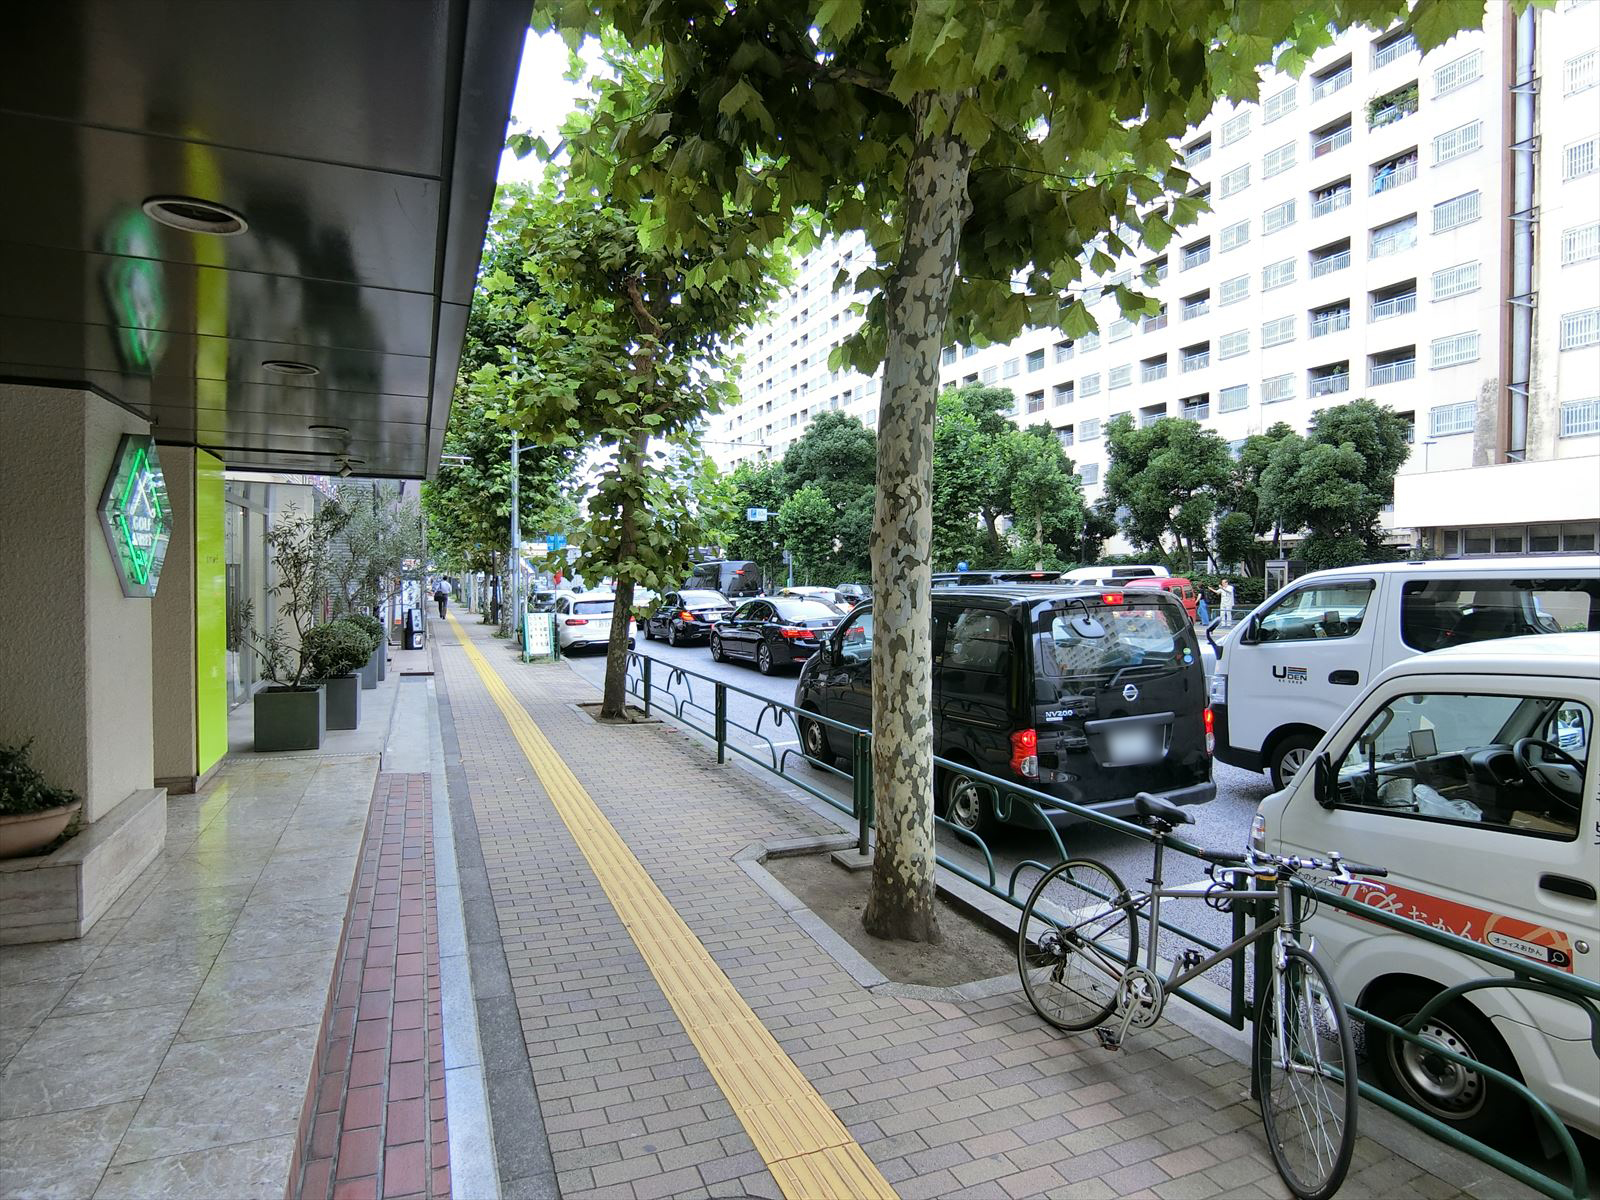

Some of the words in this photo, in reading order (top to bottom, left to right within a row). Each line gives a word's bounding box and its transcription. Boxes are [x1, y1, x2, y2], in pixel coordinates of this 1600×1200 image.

[1272, 665, 1307, 681] UDEN
[1045, 709, 1073, 718] NV200
[1494, 936, 1543, 957] オフィスおかん
